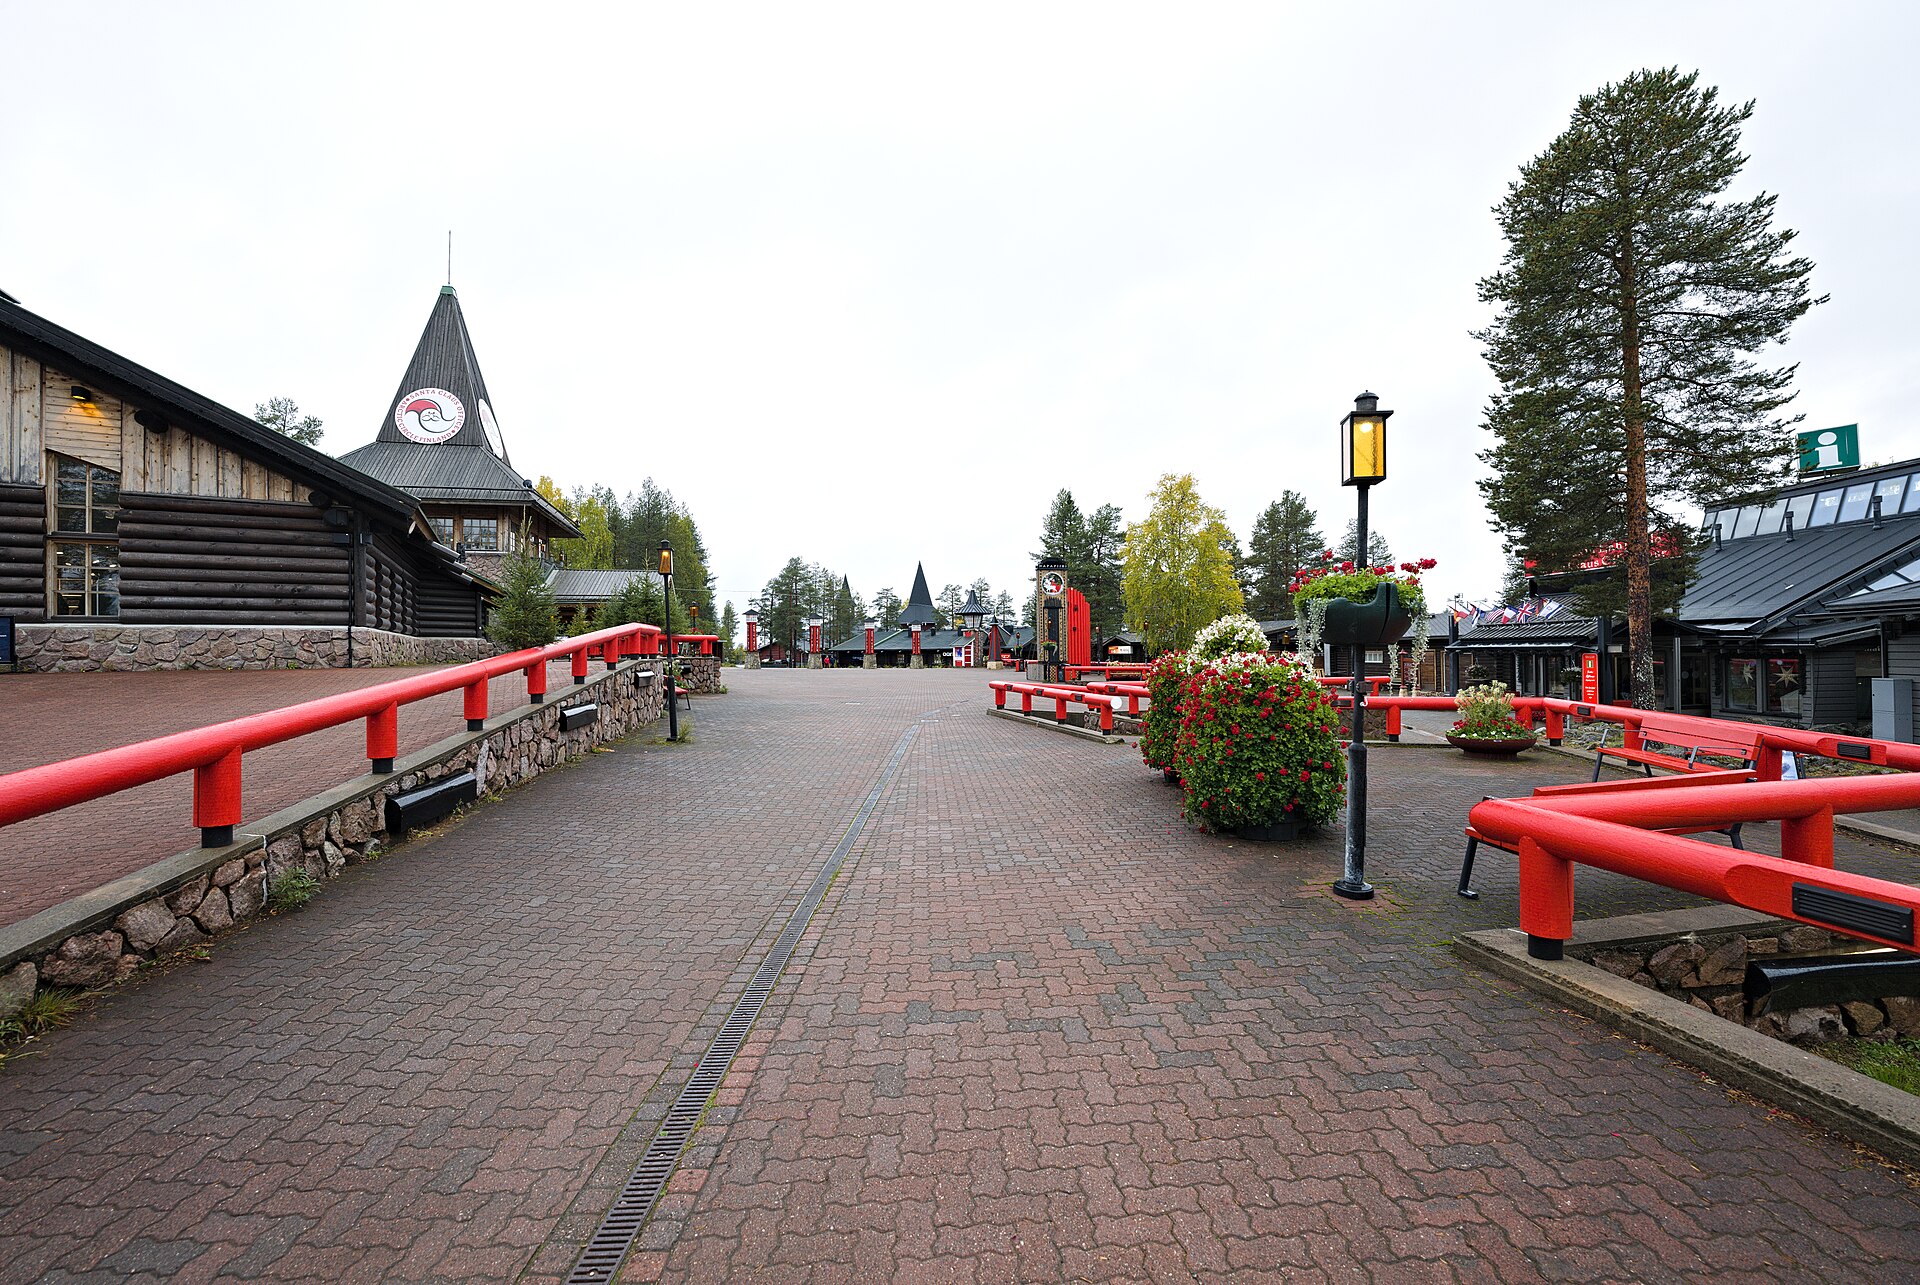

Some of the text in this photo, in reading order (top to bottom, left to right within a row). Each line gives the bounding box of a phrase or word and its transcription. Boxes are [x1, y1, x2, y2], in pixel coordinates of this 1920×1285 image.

[396, 401, 452, 442] ARCTIC CIRCLE FINLAND
[410, 389, 463, 430] SANTA CLAUS OFFICE
